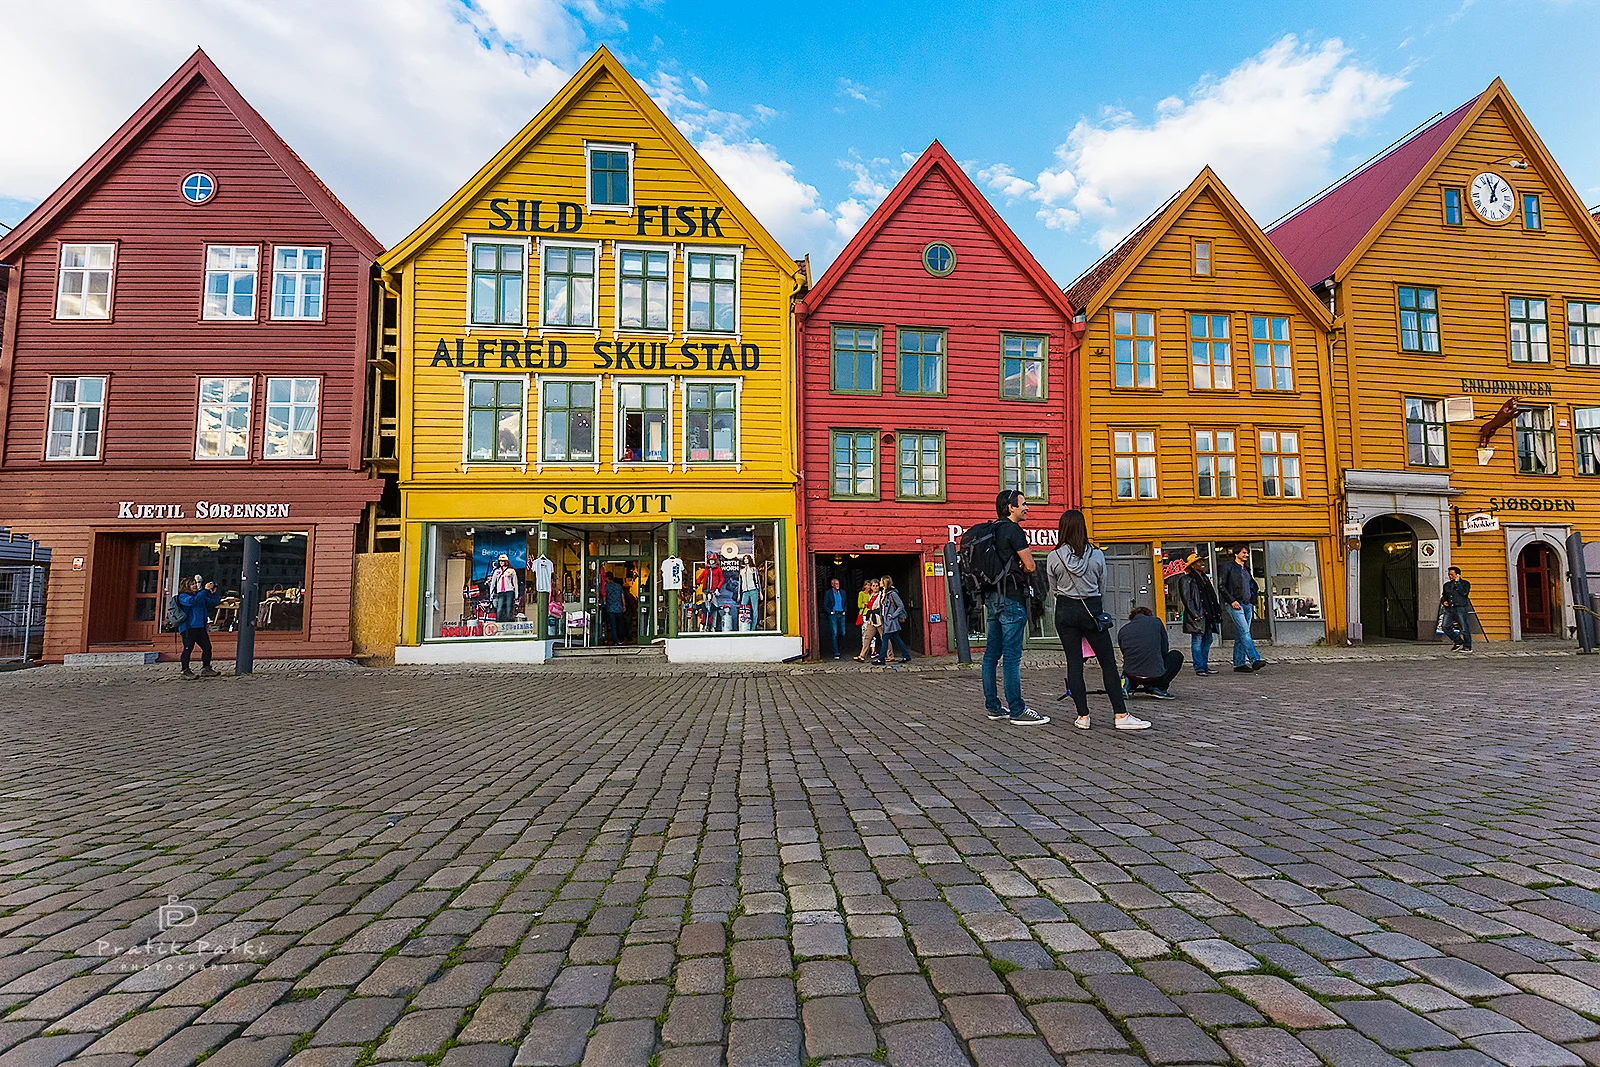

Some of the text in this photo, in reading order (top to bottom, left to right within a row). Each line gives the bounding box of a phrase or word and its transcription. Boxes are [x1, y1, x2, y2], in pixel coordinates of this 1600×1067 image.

[488, 198, 583, 233] SILD
[636, 205, 726, 237] FISK
[430, 338, 761, 371] ALFRED SKULSTAD
[543, 494, 672, 516] SCHJØTT
[1490, 498, 1575, 511] SJØBODEN
